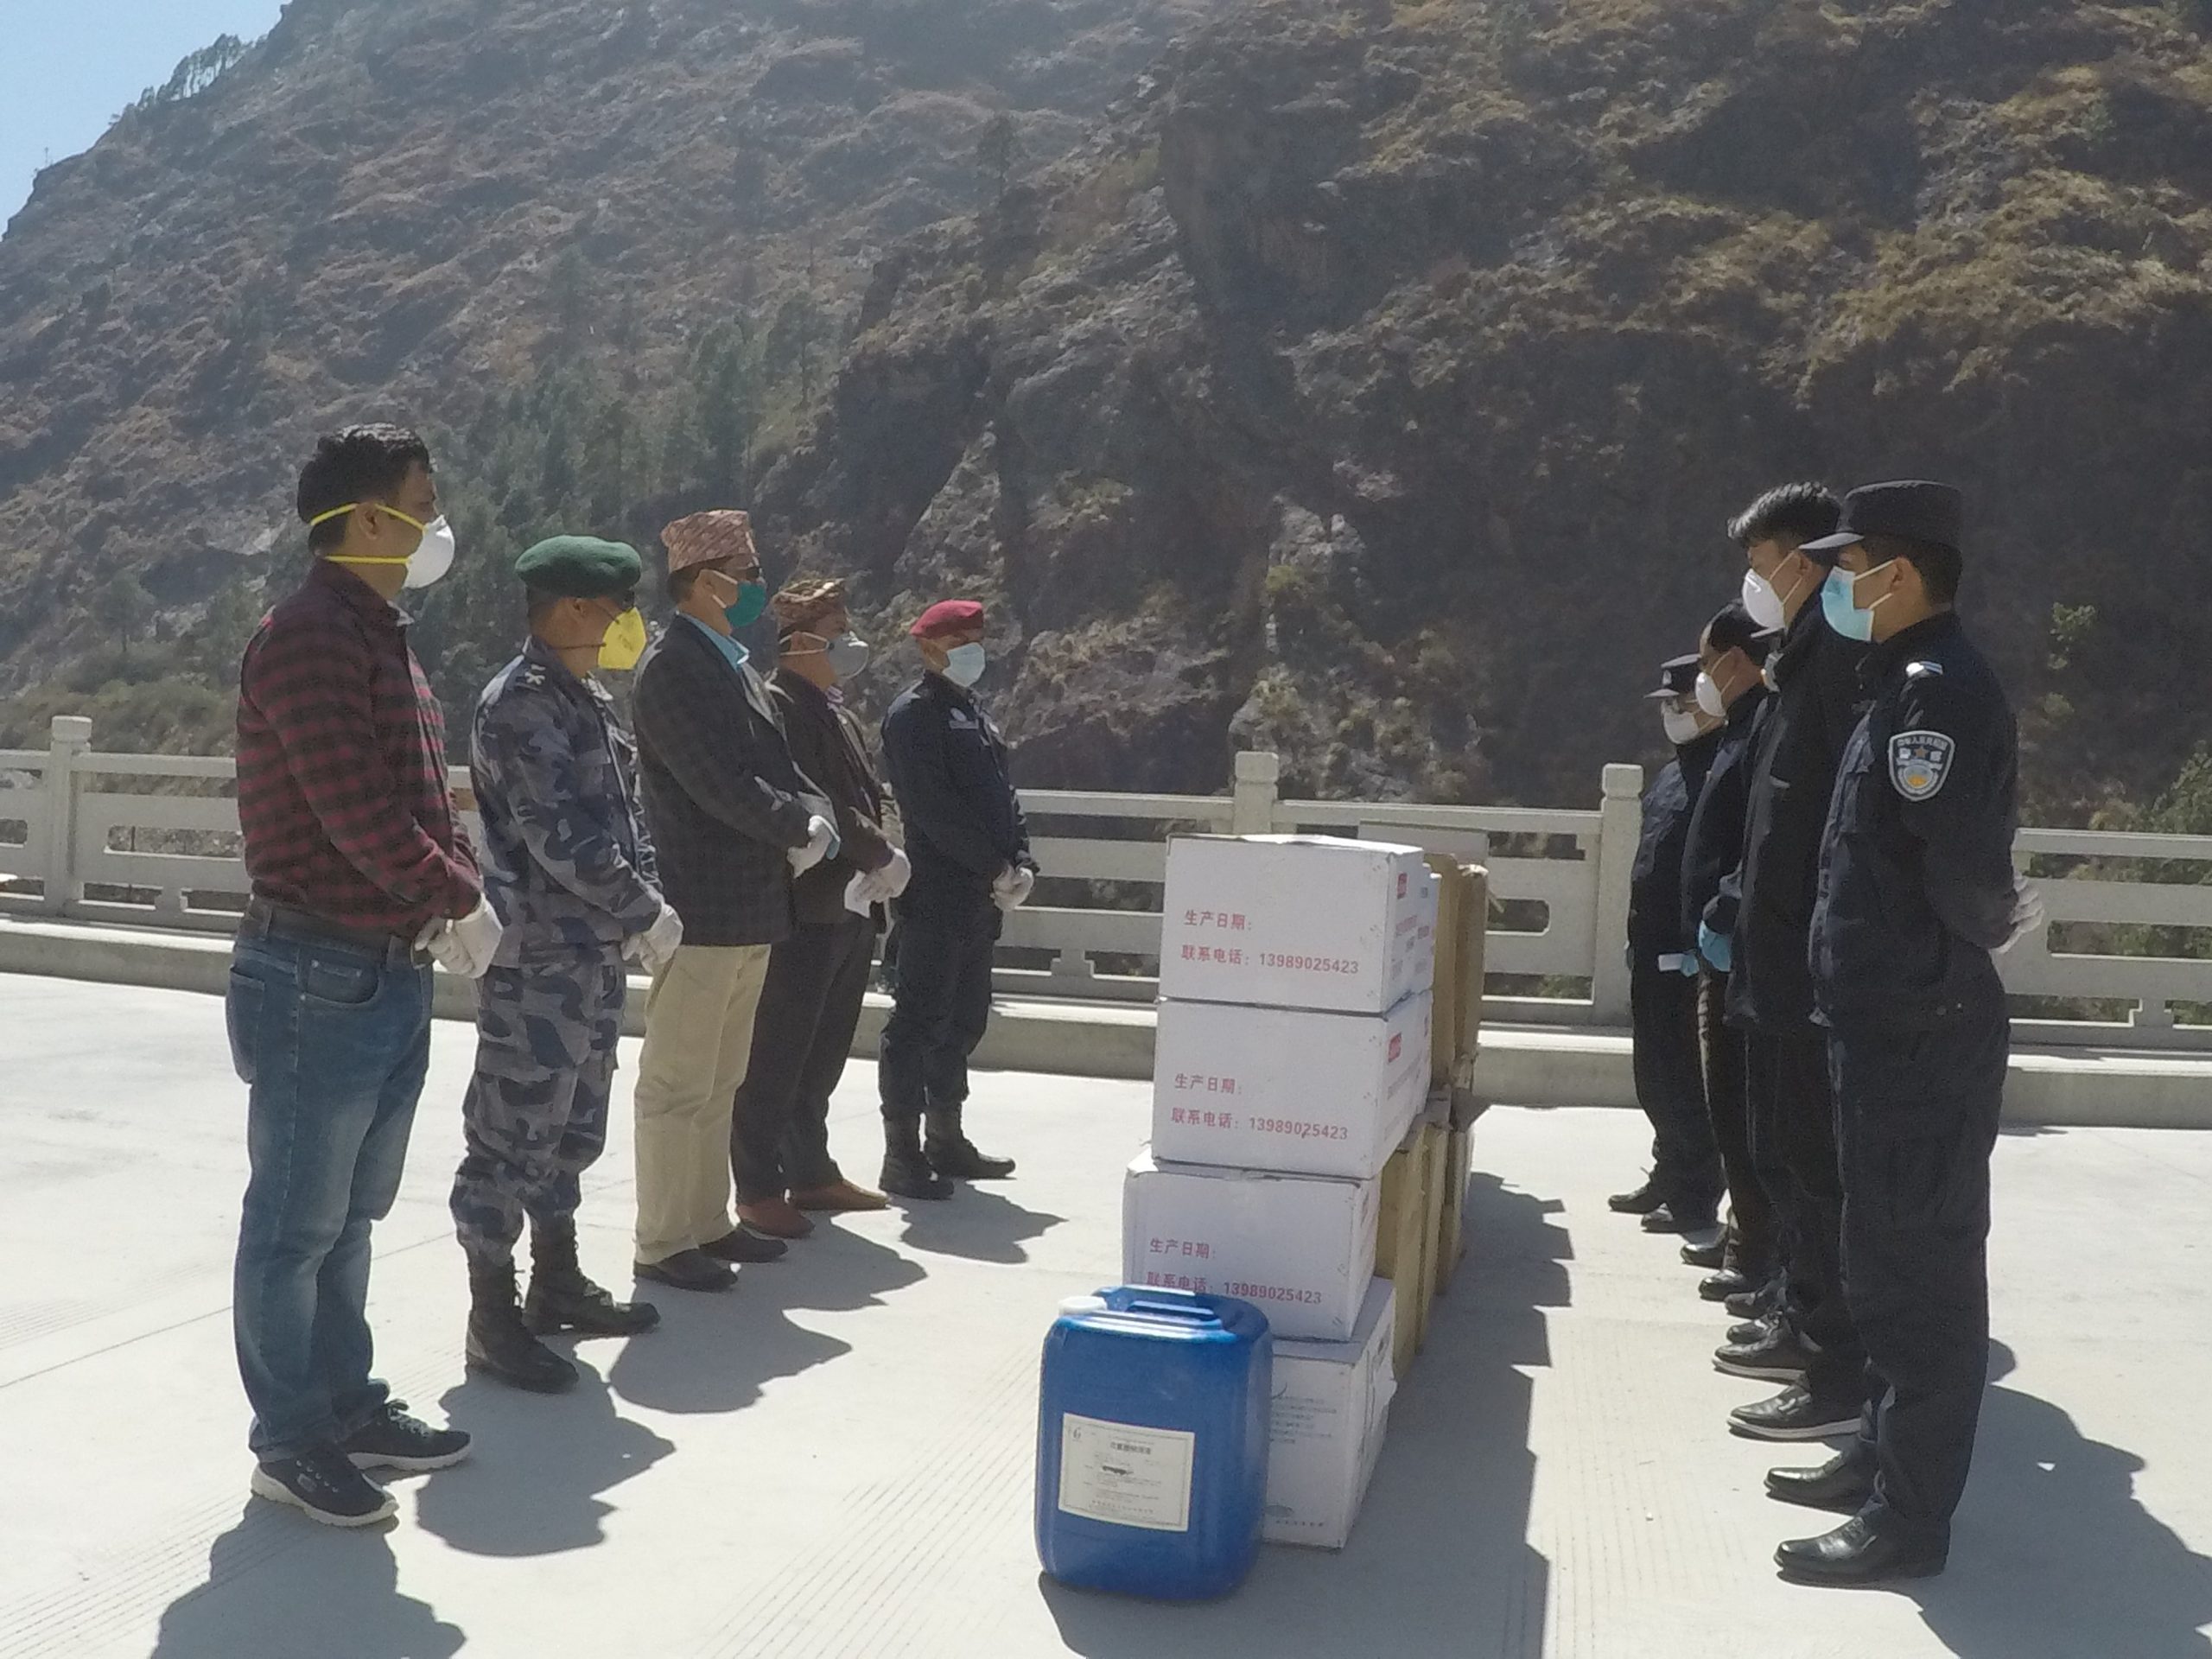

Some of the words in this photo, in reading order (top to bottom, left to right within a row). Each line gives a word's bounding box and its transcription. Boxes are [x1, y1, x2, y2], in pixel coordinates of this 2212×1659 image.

[1185, 910, 1252, 931] 生产日期：
[1174, 1073, 1242, 1095] 生产日期：
[1150, 1238, 1216, 1259] 生产日期：
